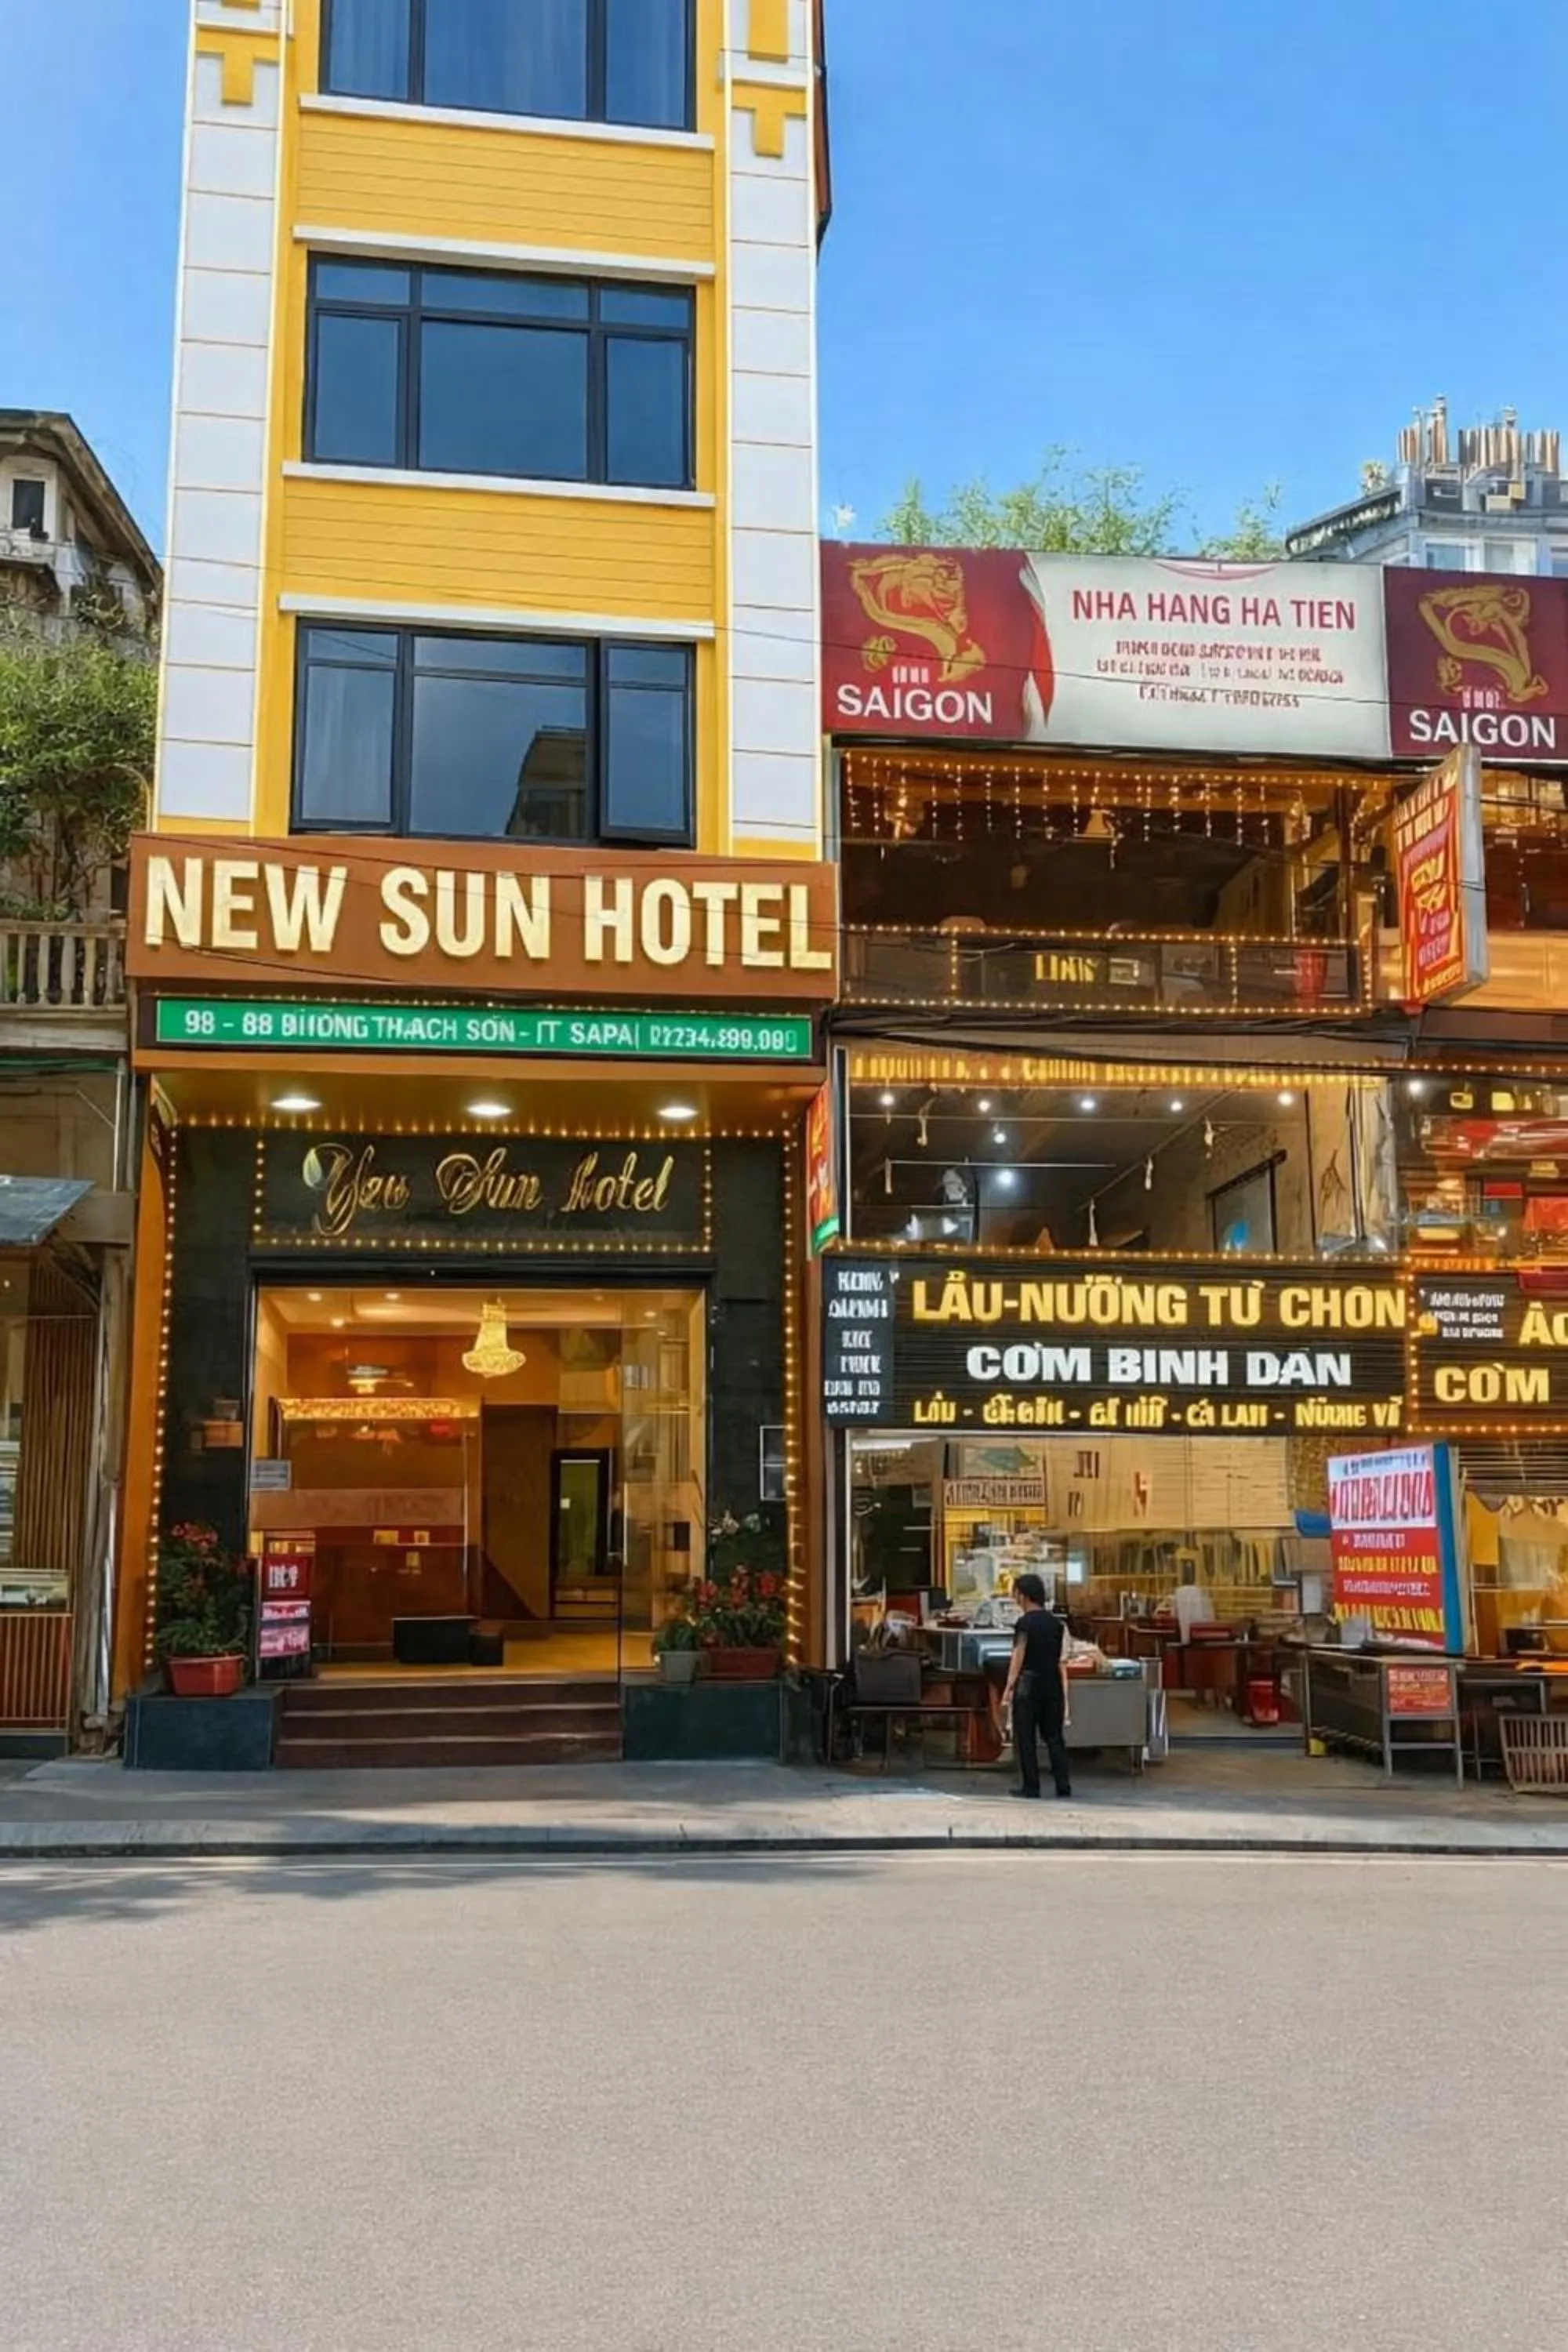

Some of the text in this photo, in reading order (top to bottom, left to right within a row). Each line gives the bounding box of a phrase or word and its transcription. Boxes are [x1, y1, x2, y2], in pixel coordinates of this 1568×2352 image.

[1073, 590, 1356, 630] NHA HANG HA TIEN
[837, 683, 993, 724] SAIGON
[1409, 708, 1556, 750] SAIGON
[144, 855, 833, 971] NEW SUN HOTEL
